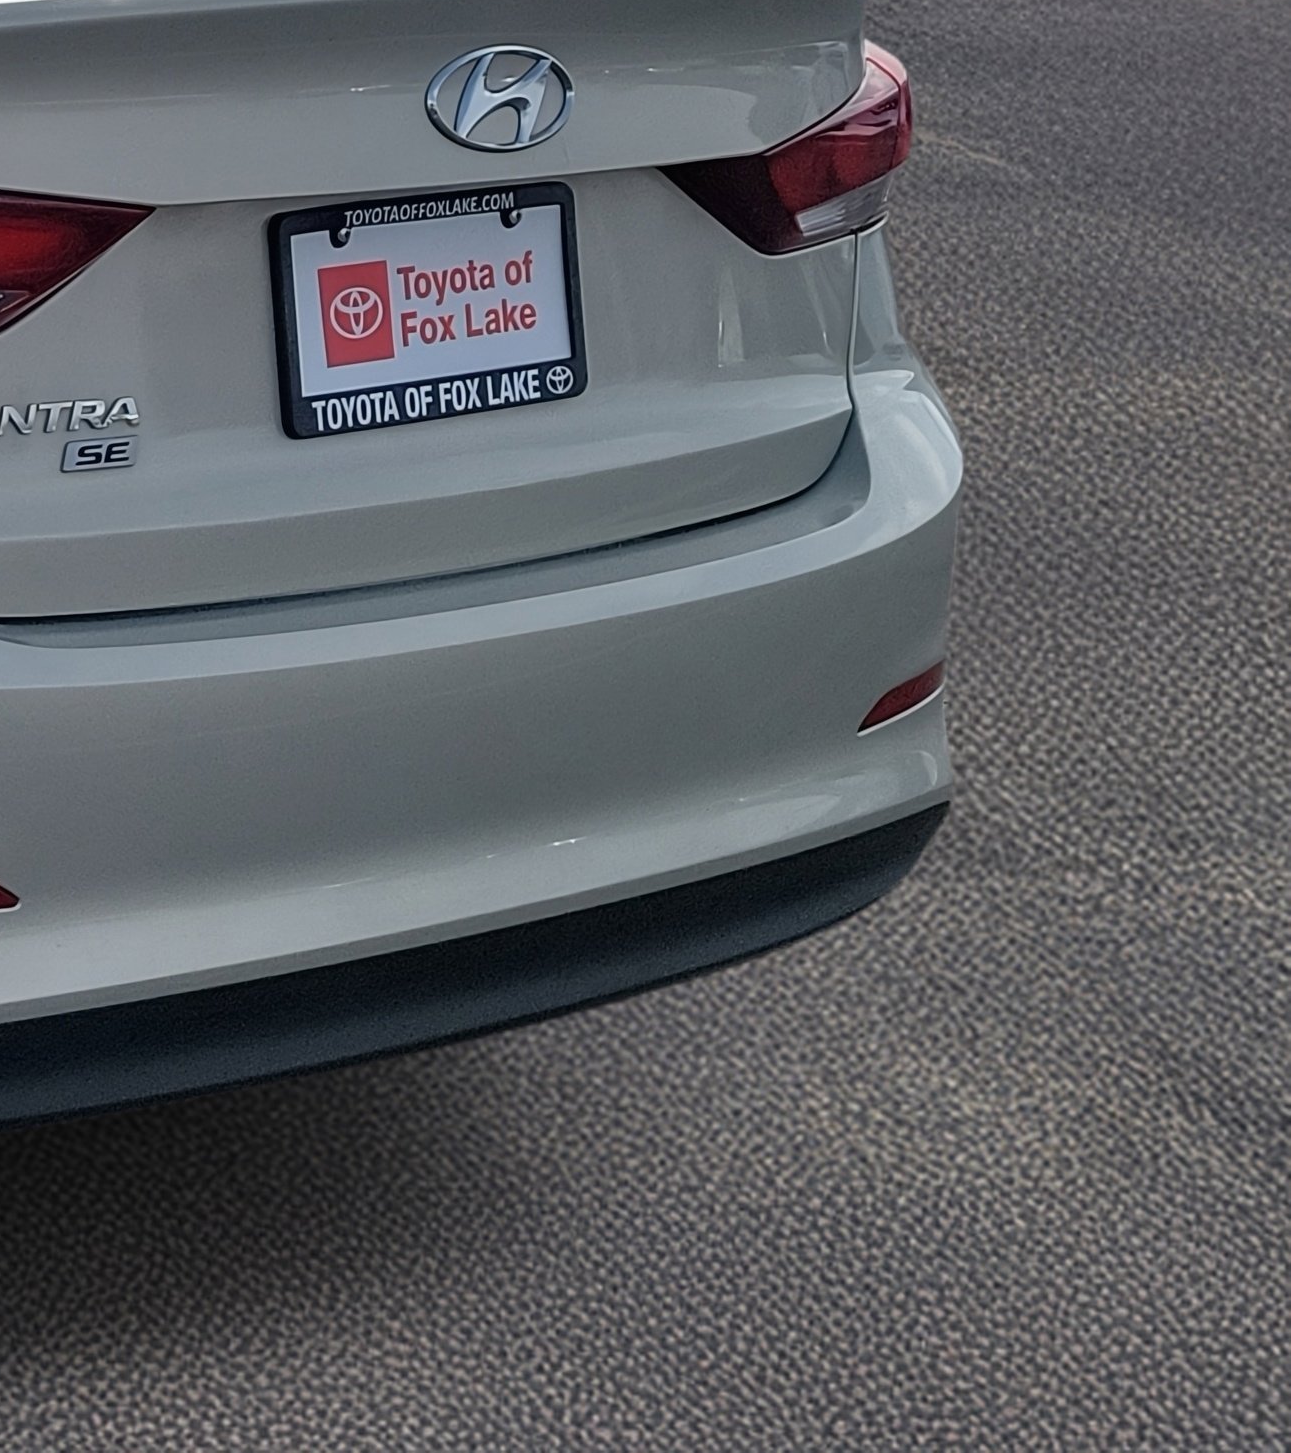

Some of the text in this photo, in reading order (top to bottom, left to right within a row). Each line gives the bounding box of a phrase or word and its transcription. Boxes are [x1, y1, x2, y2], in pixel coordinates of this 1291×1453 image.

[344, 192, 514, 227] TOYOTAOFFOXLAKE.COM
[396, 250, 534, 306] Toyota of
[400, 298, 537, 347] Fox Lake
[312, 368, 542, 431] TOYOTA OF FOX LAKE
[75, 441, 130, 466] SE
